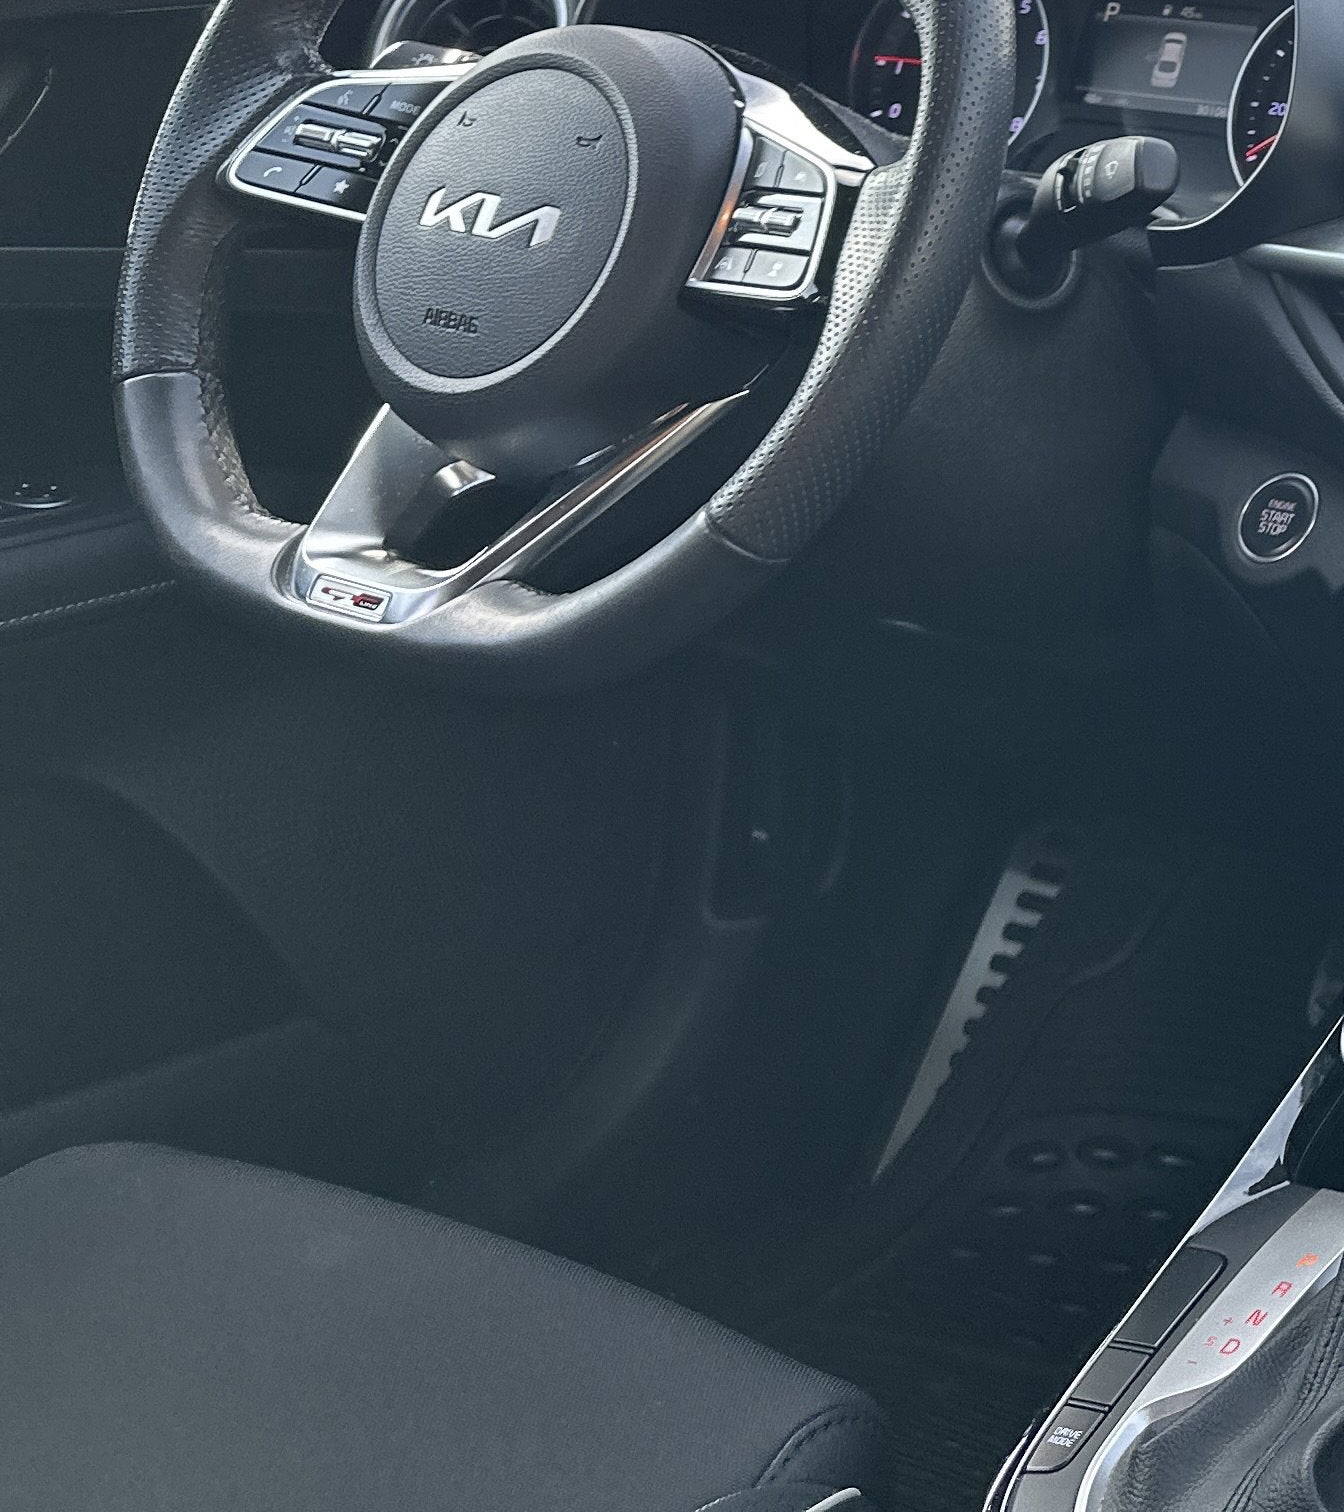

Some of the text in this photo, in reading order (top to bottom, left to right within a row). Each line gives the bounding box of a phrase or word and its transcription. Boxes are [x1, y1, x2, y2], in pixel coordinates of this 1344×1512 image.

[1103, 1, 1121, 22] P
[390, 100, 421, 115] MODE
[888, 102, 902, 119] 0
[1268, 101, 1289, 116] 20
[419, 186, 562, 248] KIA
[422, 307, 481, 334] AIRBAG
[1259, 509, 1296, 524] START
[1257, 521, 1288, 536] STOP
[1296, 1252, 1319, 1269] P
[1246, 1309, 1269, 1326] N
[1219, 1338, 1241, 1355] D
[1046, 1434, 1076, 1448] MODE
[1053, 1426, 1084, 1440] DRIVE
